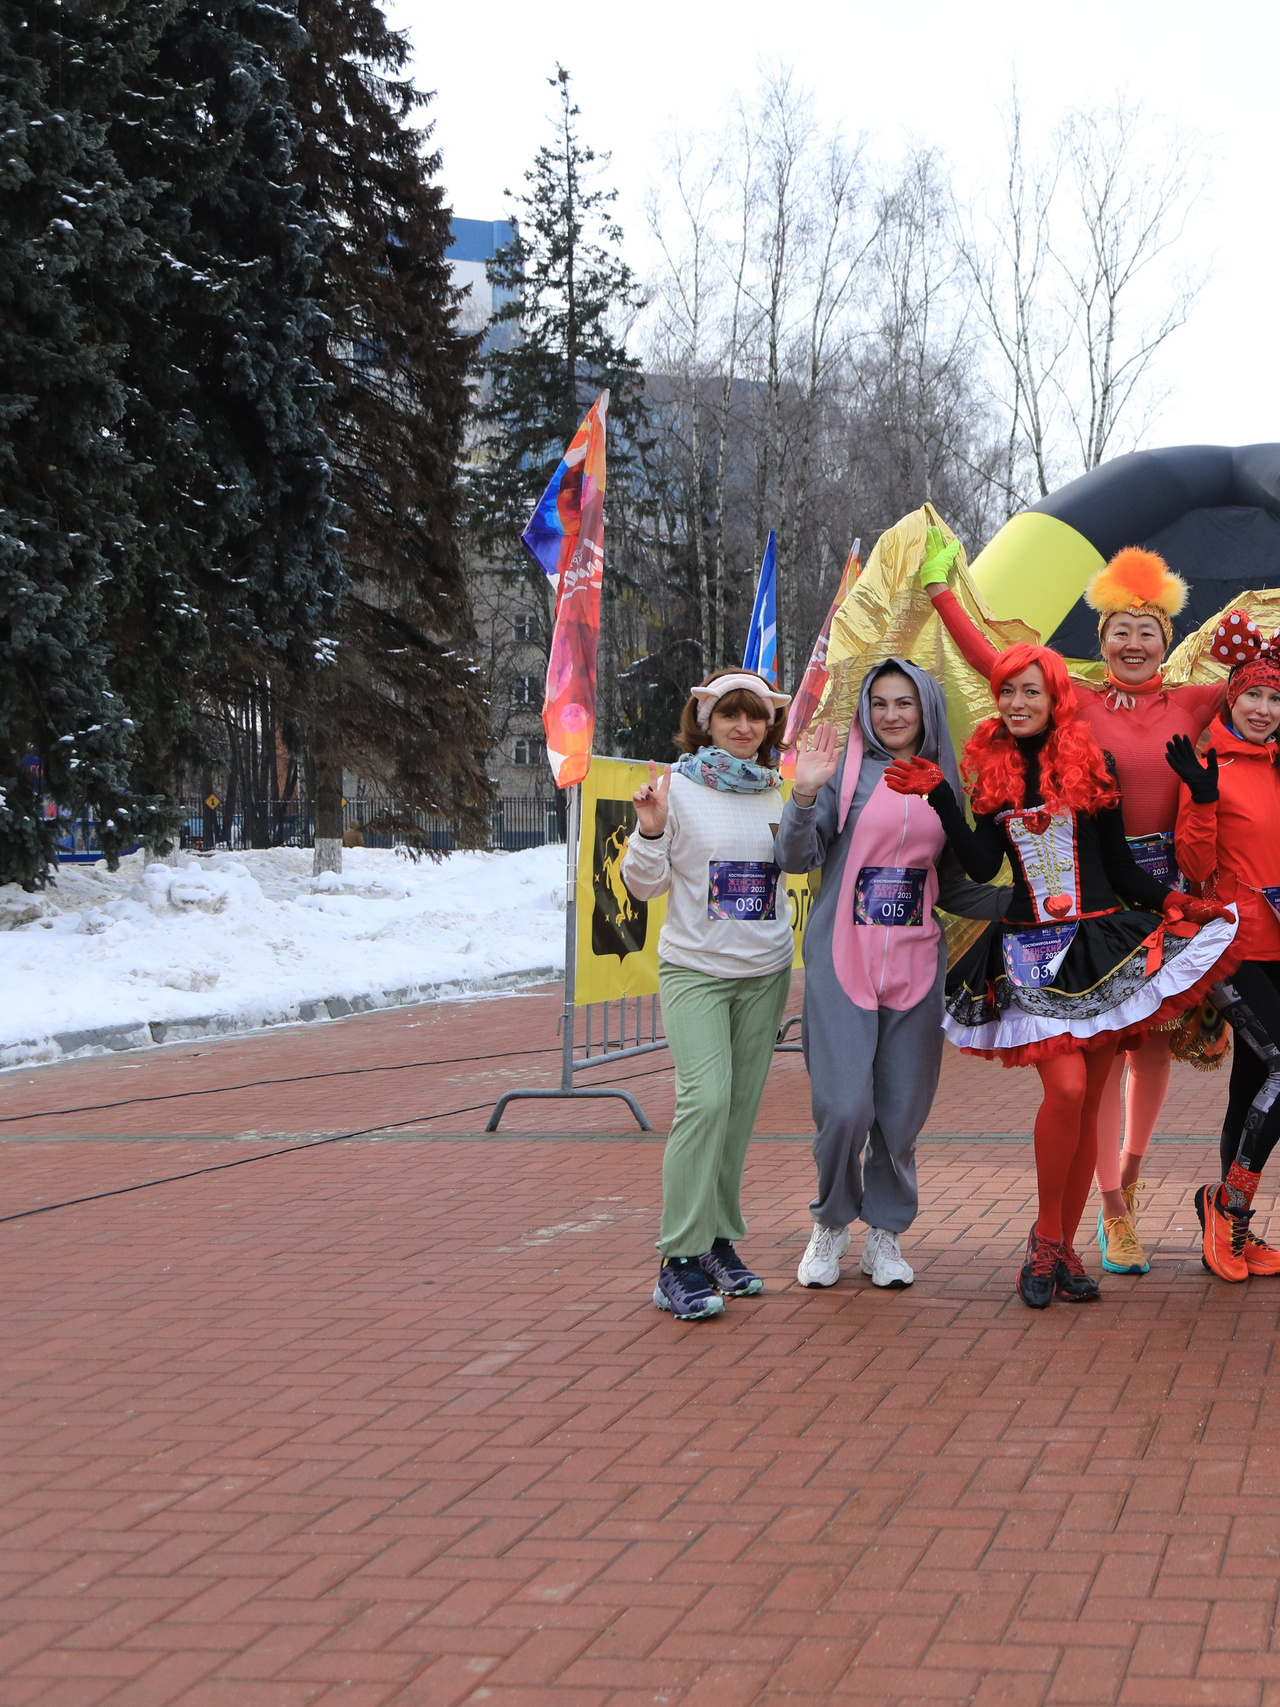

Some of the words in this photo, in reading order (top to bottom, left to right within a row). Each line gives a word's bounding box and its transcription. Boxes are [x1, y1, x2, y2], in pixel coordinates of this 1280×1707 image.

[1153, 867, 1169, 875] 2023
[736, 898, 763, 912] 030
[882, 903, 904, 917] 015
